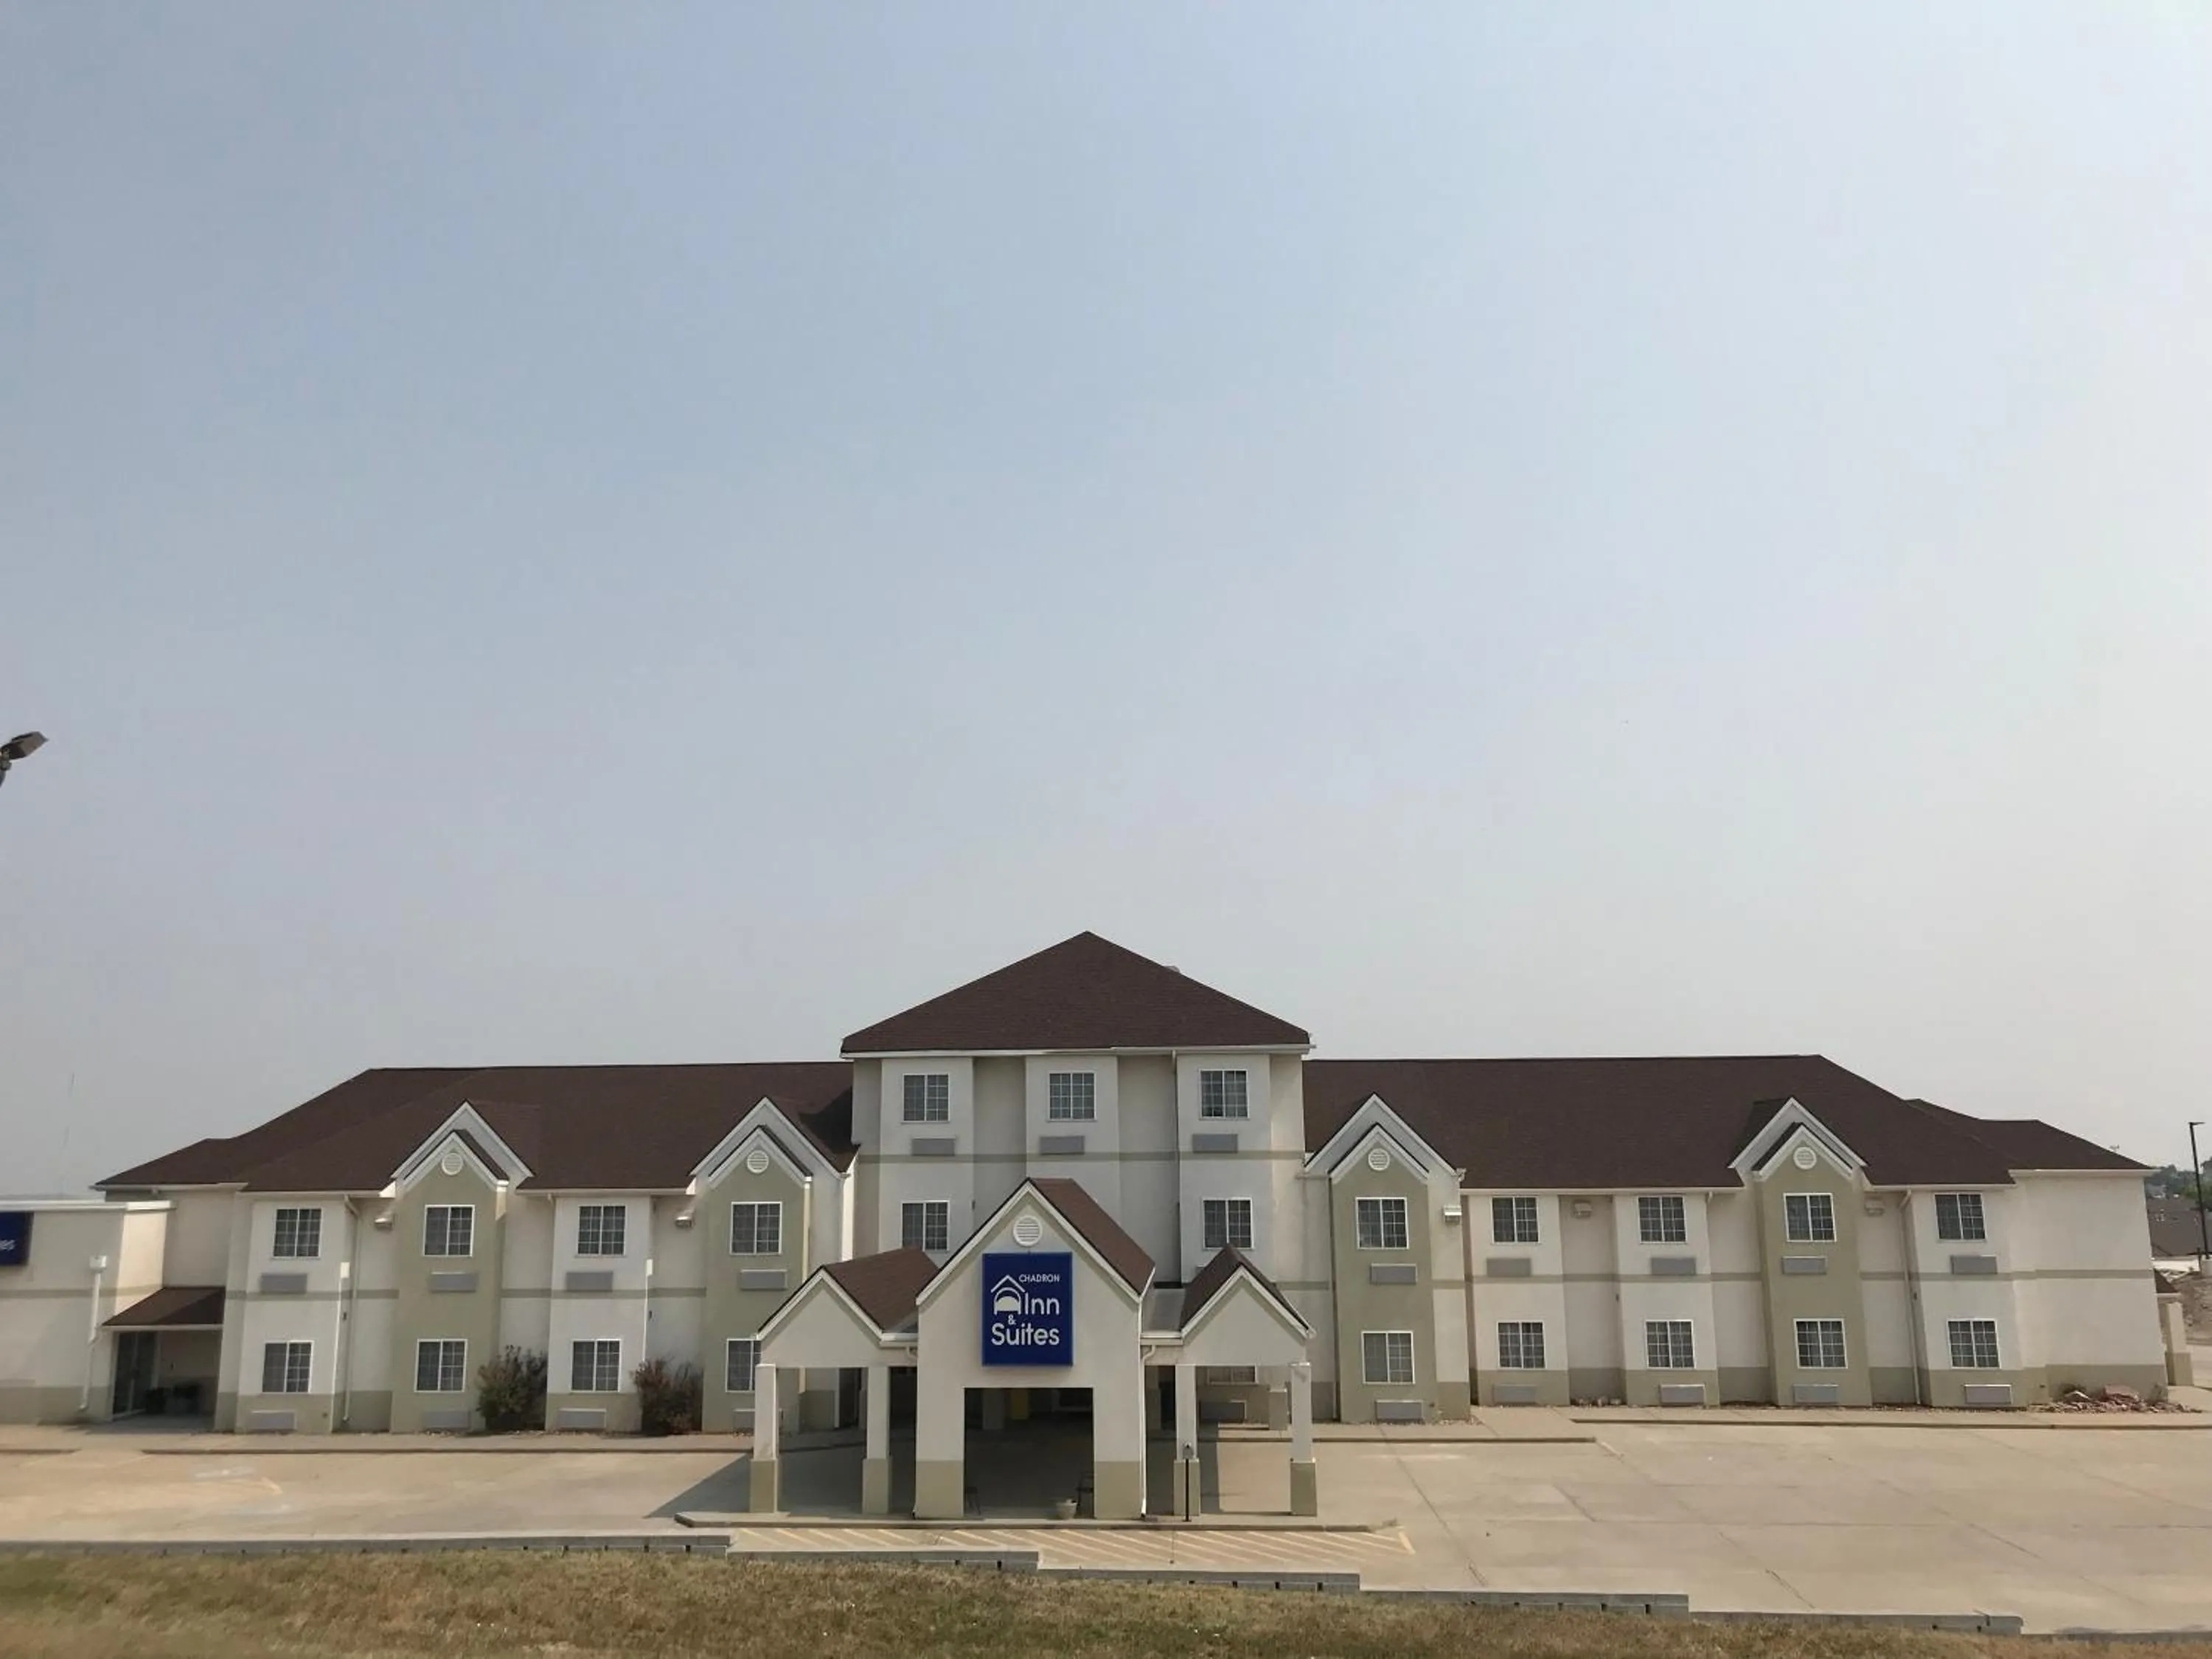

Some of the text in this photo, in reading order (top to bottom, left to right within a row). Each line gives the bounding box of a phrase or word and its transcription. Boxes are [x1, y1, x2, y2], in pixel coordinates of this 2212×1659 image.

[1018, 1274, 1060, 1282] CHADRON
[1025, 1293, 1060, 1315] Inn
[1008, 1315, 1016, 1325] &
[991, 1323, 1060, 1345] Suites
